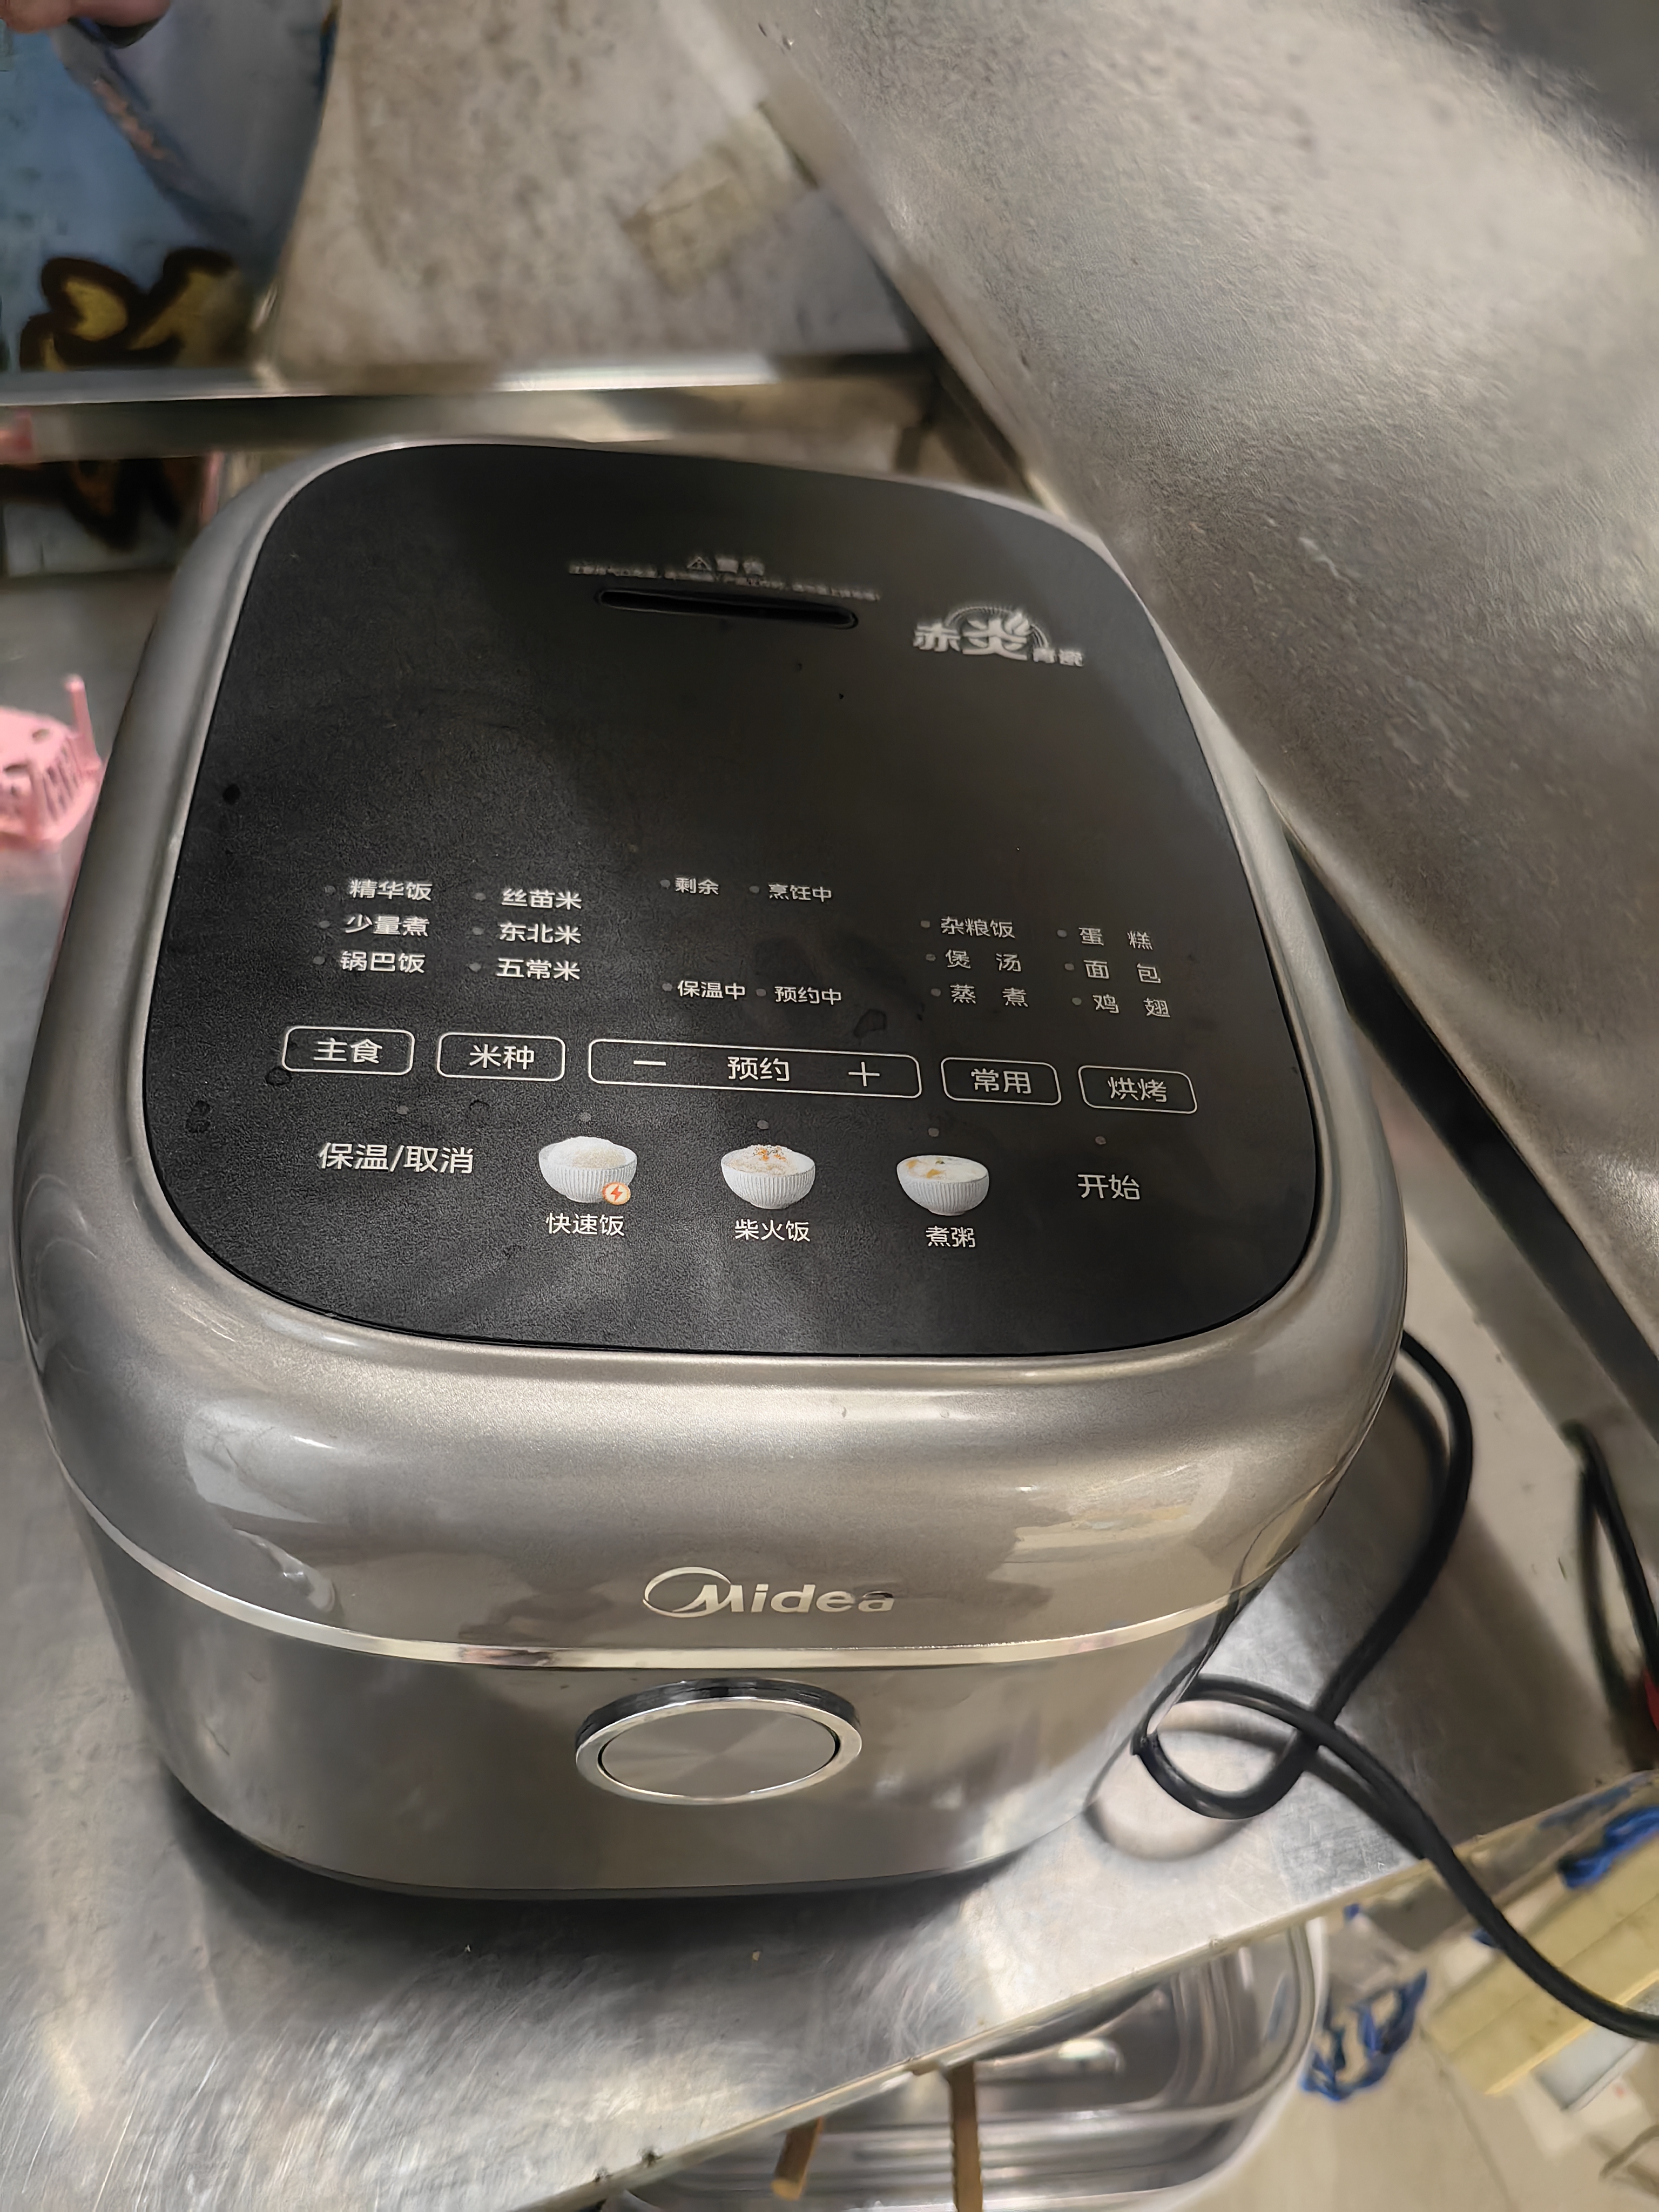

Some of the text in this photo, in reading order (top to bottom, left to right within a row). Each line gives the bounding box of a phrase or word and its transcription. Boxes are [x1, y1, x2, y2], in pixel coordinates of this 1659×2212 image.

[349, 879, 433, 901] 精华饭
[675, 877, 719, 895] 剩余
[768, 884, 832, 902] 烹饪中
[501, 888, 582, 910] 丝苗米
[345, 914, 430, 937] 少量煮
[500, 922, 581, 945] 东北米
[941, 916, 1015, 939] 杂粮饭
[340, 950, 426, 973] 锅巴饭
[496, 957, 580, 981] 五常米
[677, 980, 745, 1000] 保温中
[774, 986, 841, 1005] 预约中
[313, 1037, 383, 1064] 主食
[469, 1044, 535, 1070] 米种
[727, 1056, 790, 1082] 预约
[971, 1068, 1031, 1094] 常用
[1107, 1076, 1167, 1102] 烘烤
[319, 1142, 474, 1174] 保温/取消
[1077, 1174, 1140, 1200] 开始
[545, 1212, 625, 1236] 快速饭
[734, 1218, 810, 1242] 柴火饭
[926, 1225, 975, 1247] 煮粥
[643, 1567, 894, 1617] Midea
